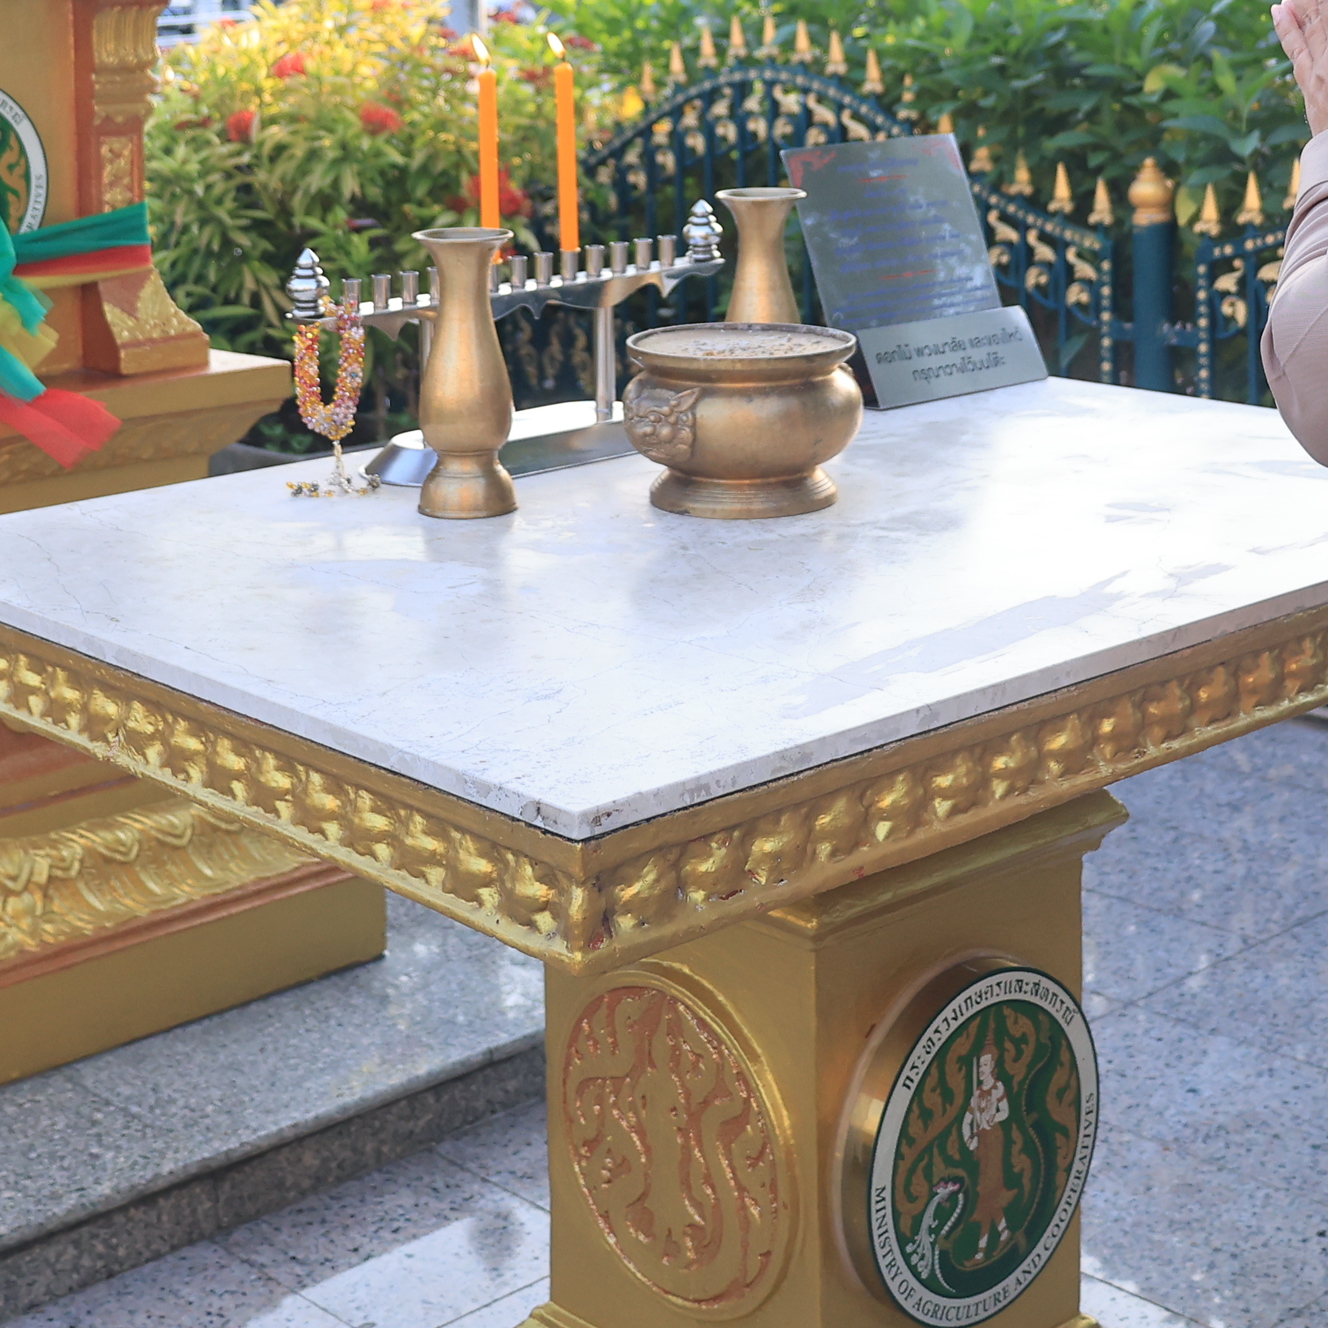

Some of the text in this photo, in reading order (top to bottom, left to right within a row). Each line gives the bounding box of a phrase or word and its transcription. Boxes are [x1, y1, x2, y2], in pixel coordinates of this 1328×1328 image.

[874, 1091, 1096, 1323] MINISTRY OF AGRICULTURE AND COOPERATIVES
